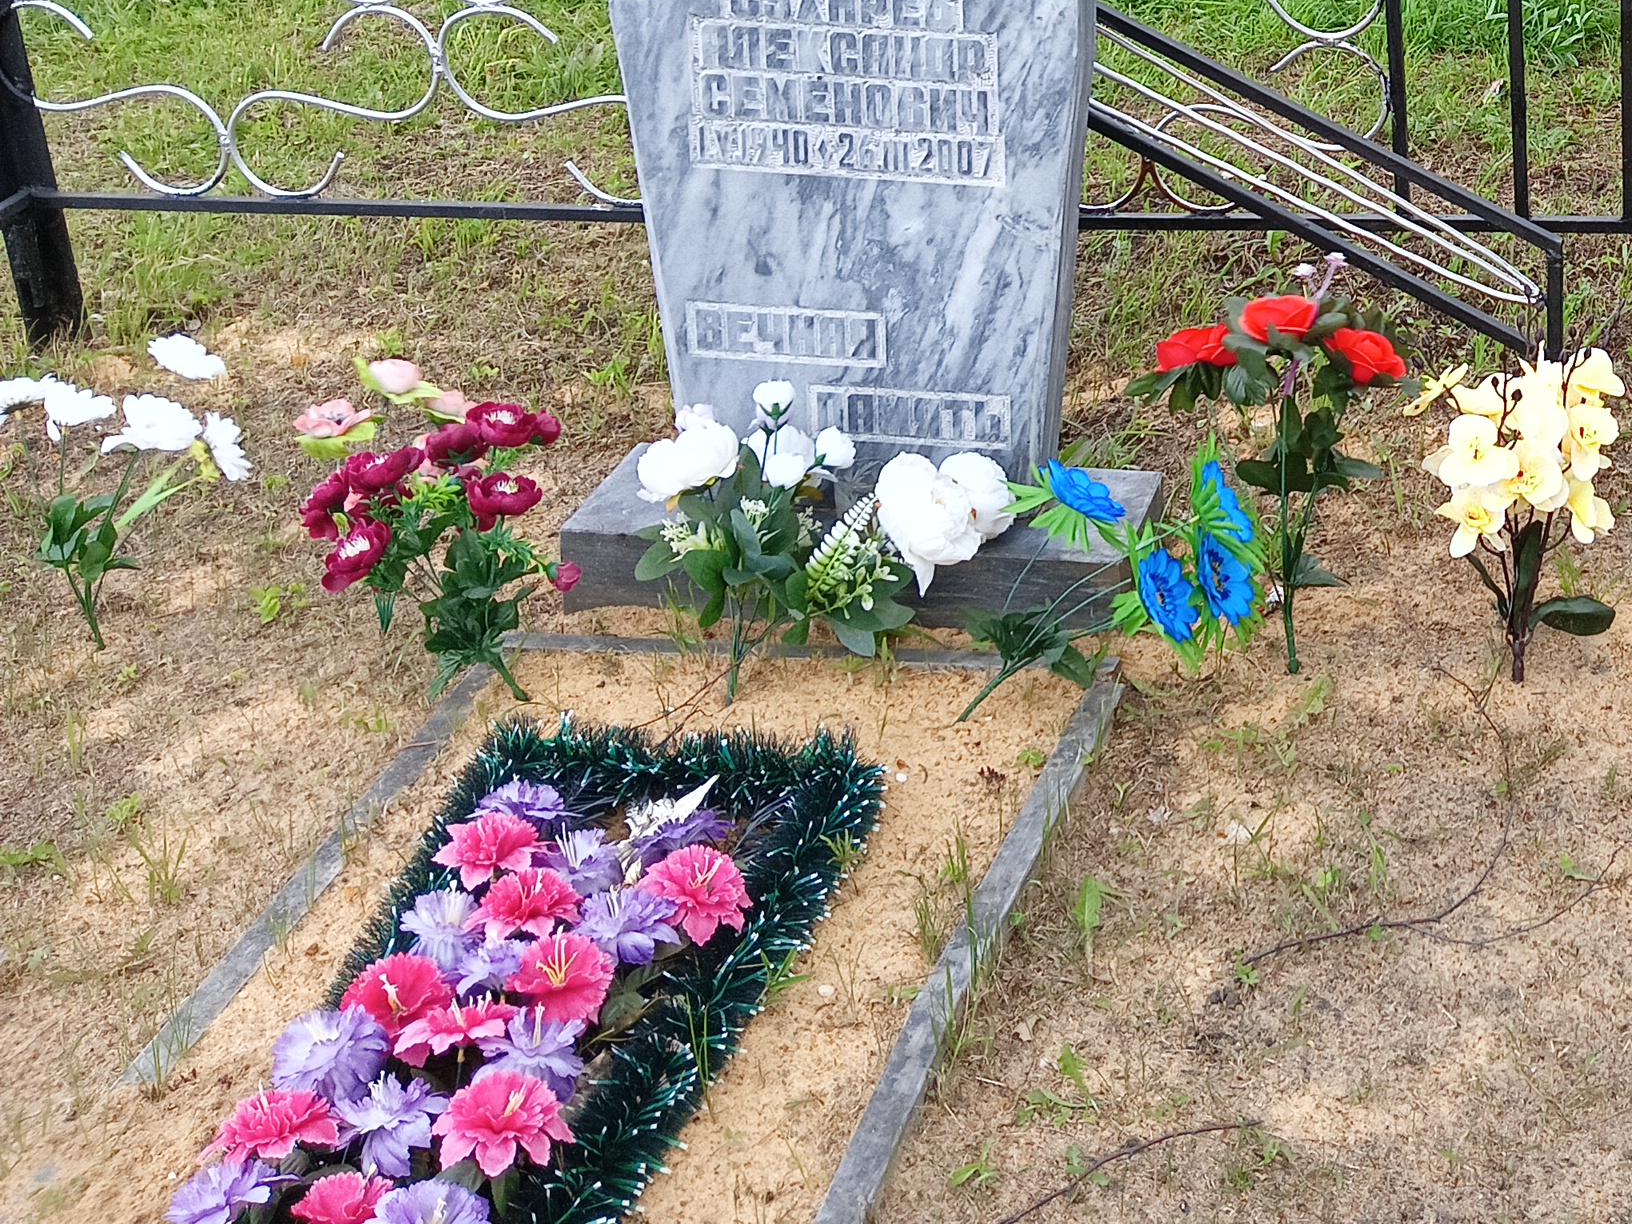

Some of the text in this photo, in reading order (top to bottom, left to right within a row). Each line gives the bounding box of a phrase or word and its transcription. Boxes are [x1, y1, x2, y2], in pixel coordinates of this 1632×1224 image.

[699, 22, 990, 81] АЛЕКСАНДР
[695, 306, 878, 359] ВЕЧНАЯ
[816, 390, 1005, 442] ПАМЯТЬ
